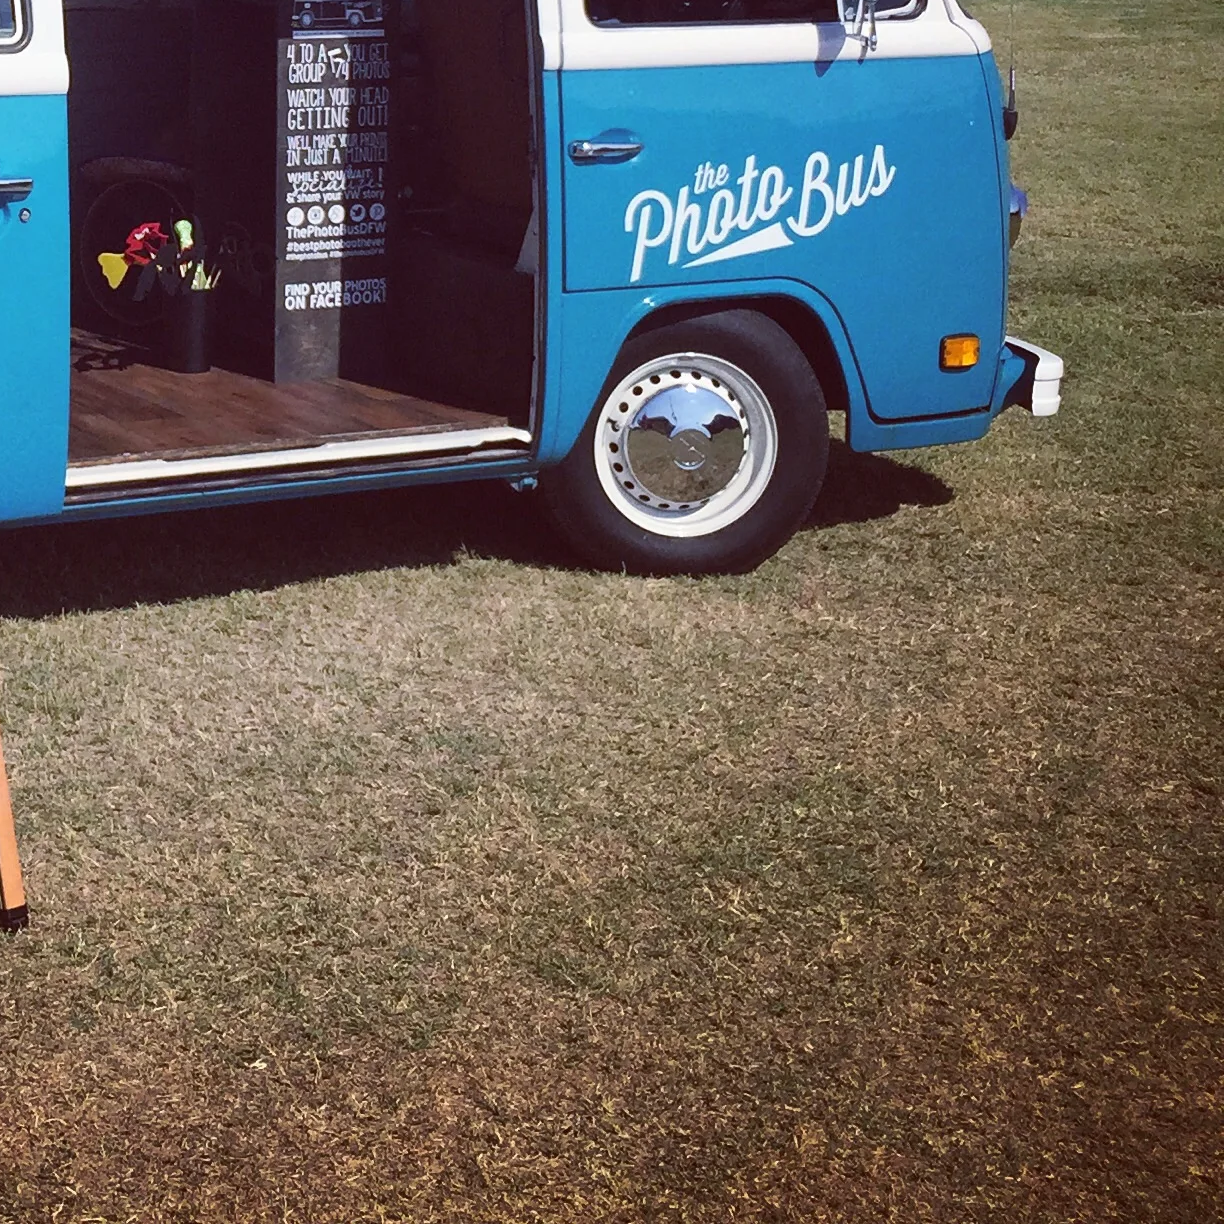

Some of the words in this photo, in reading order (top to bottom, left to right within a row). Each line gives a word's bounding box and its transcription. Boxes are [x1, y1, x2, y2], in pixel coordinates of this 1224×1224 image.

[286, 44, 296, 64] 4
[300, 43, 314, 64] TO
[318, 44, 328, 63] A
[344, 42, 366, 62] YOU
[368, 42, 389, 61] GET
[288, 62, 326, 84] GROUP
[352, 61, 390, 80] PHOTOS
[286, 88, 325, 108] WATCH
[328, 88, 357, 106] YOUR
[360, 86, 390, 105] HEAD
[287, 107, 350, 130] GETTING
[358, 105, 388, 126] OUT!
[312, 134, 336, 149] MAKE
[286, 148, 300, 166] IN
[304, 148, 329, 166] JUST
[332, 148, 342, 164] A
[286, 170, 320, 183] WHILE
[322, 170, 346, 181] YOU
[693, 161, 730, 196] the
[323, 192, 343, 204] your
[344, 190, 361, 200] VW
[362, 190, 386, 200] story
[624, 155, 793, 283] Photo
[787, 145, 896, 237] Bus
[286, 222, 386, 239] ThePhotoBusDFW
[284, 283, 310, 296] FIND
[312, 281, 342, 295] YOUR
[344, 277, 386, 292] PHOTOS
[284, 296, 306, 311] ON
